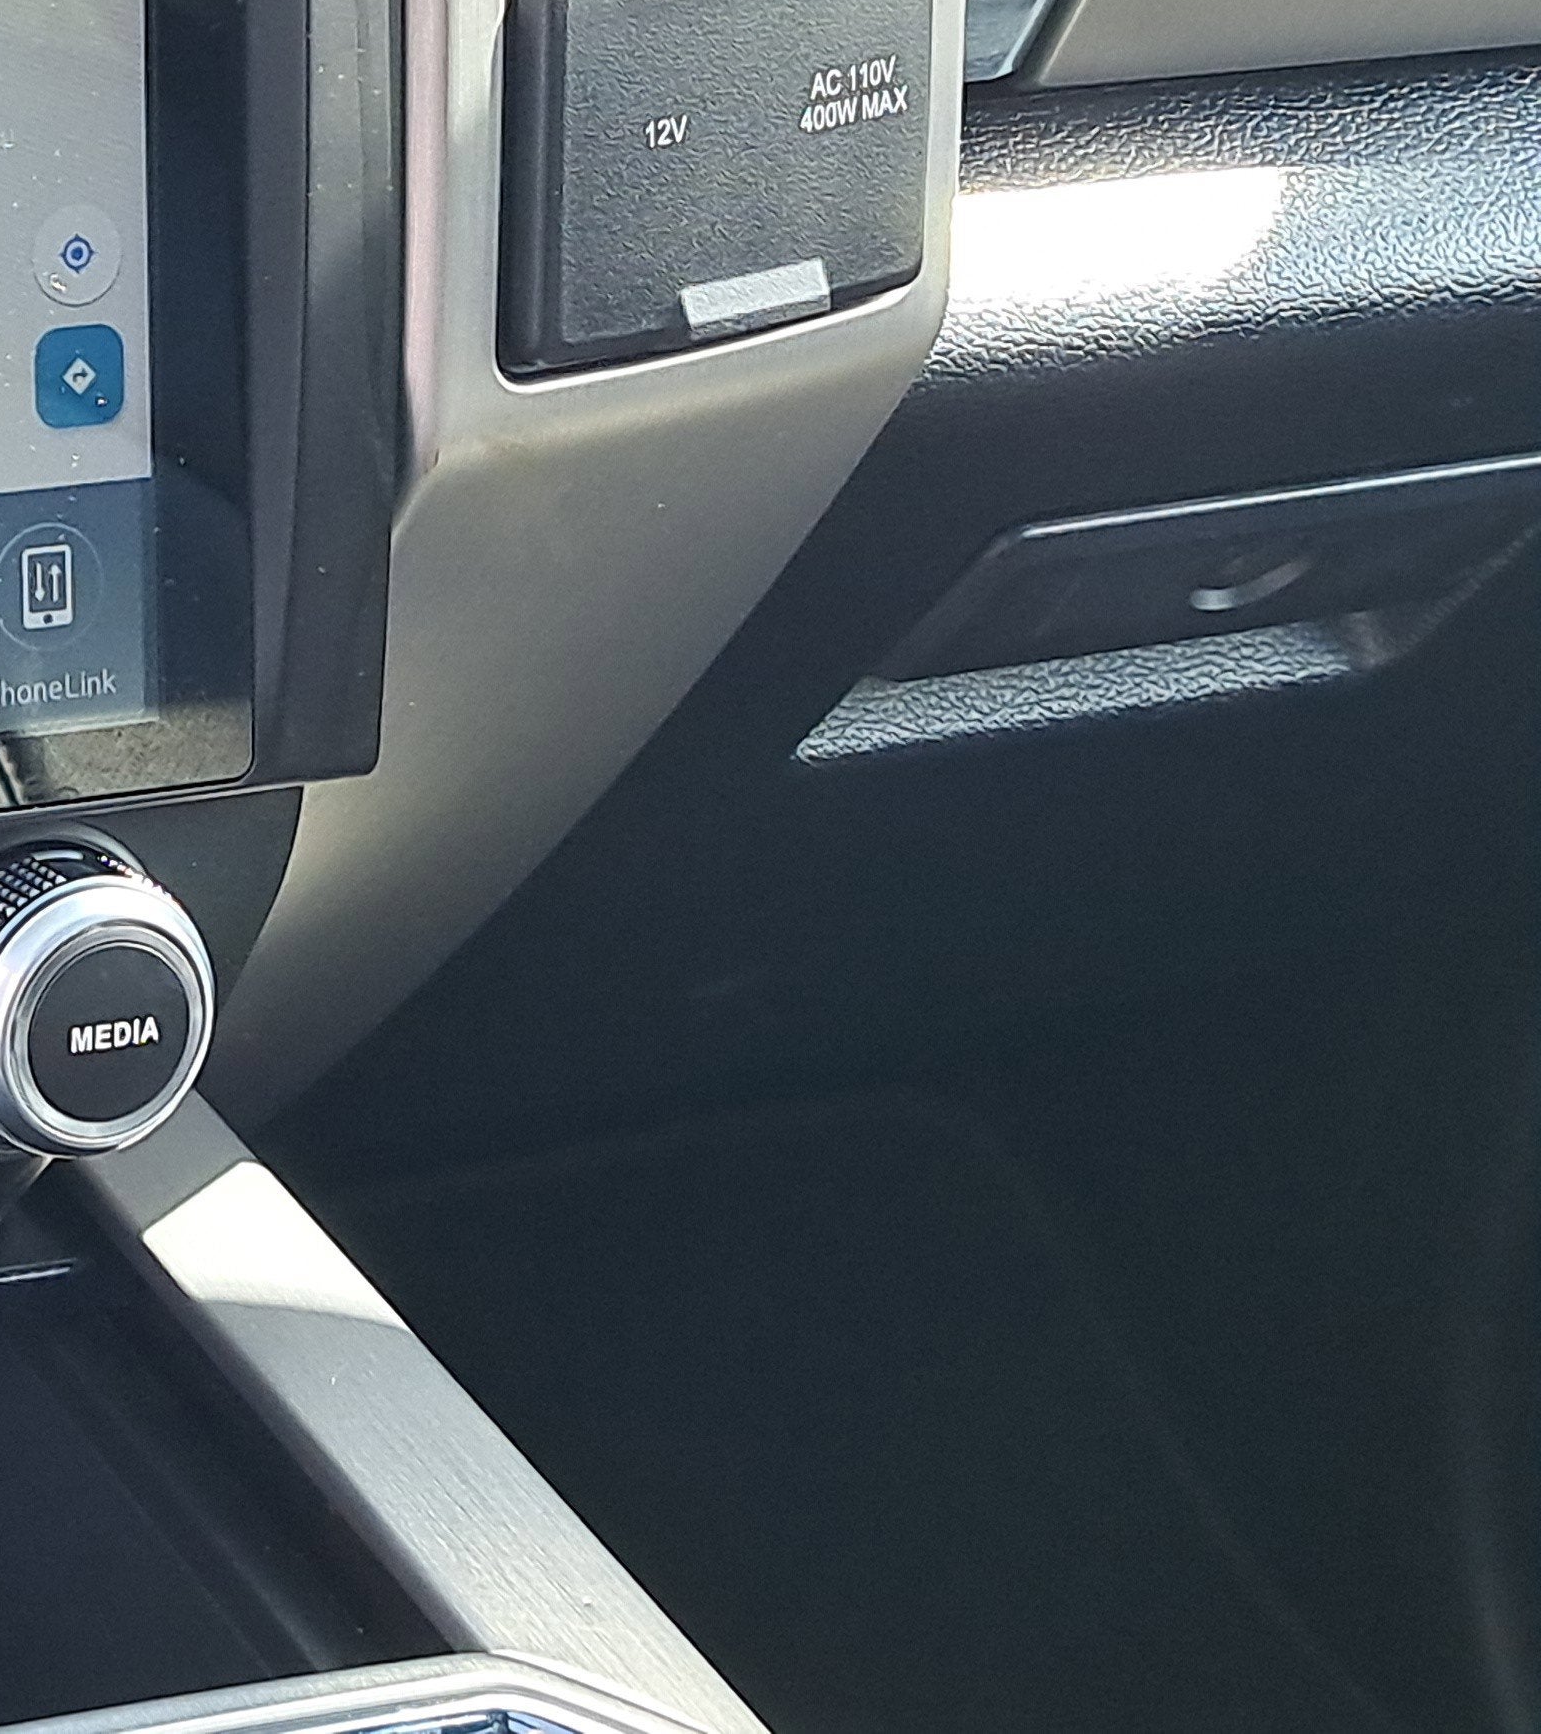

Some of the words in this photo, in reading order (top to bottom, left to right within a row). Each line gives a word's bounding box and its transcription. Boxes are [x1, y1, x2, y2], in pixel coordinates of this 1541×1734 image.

[811, 69, 843, 100] AC
[850, 55, 897, 92] 110V
[800, 99, 857, 134] 400W
[861, 86, 908, 122] MAX
[644, 116, 688, 148] 12V
[69, 1016, 160, 1054] MEDIA
